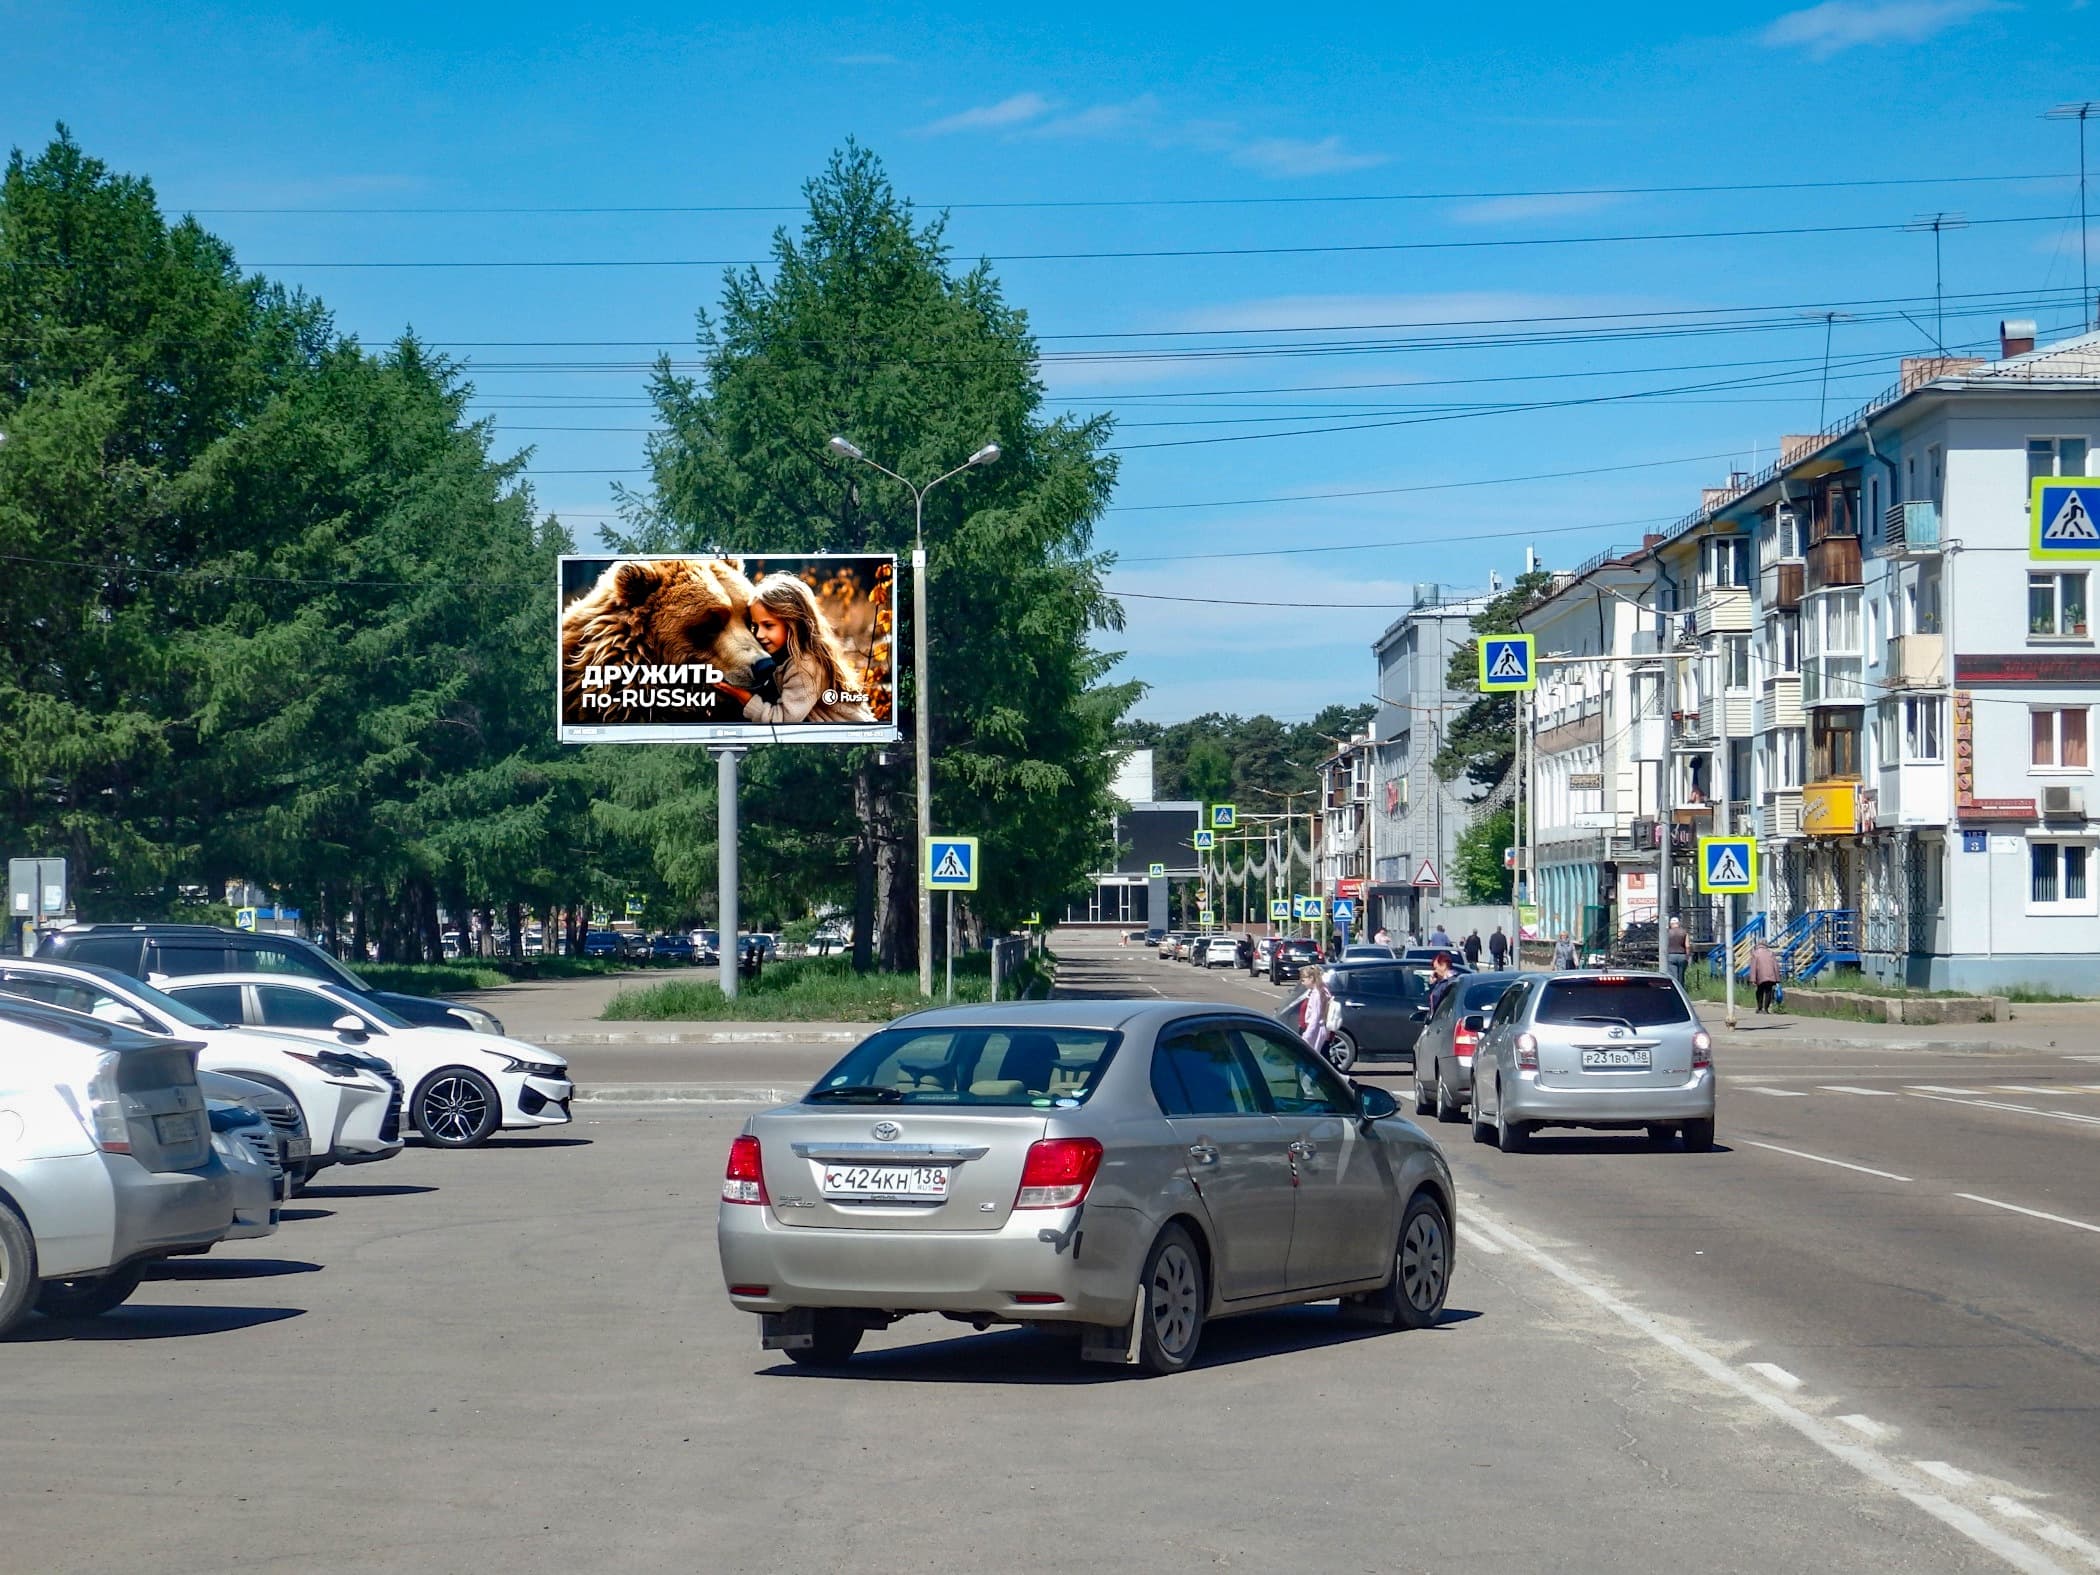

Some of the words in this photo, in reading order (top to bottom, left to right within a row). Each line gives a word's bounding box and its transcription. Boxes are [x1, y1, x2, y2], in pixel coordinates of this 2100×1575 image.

[582, 664, 724, 689] ДРУЖИТЬ
[582, 688, 716, 708] по-RUSSки
[840, 691, 869, 702] Russ
[1586, 1053, 1629, 1064] Р231ВО
[831, 1168, 909, 1190] С424КН
[913, 1167, 943, 1185] 138
